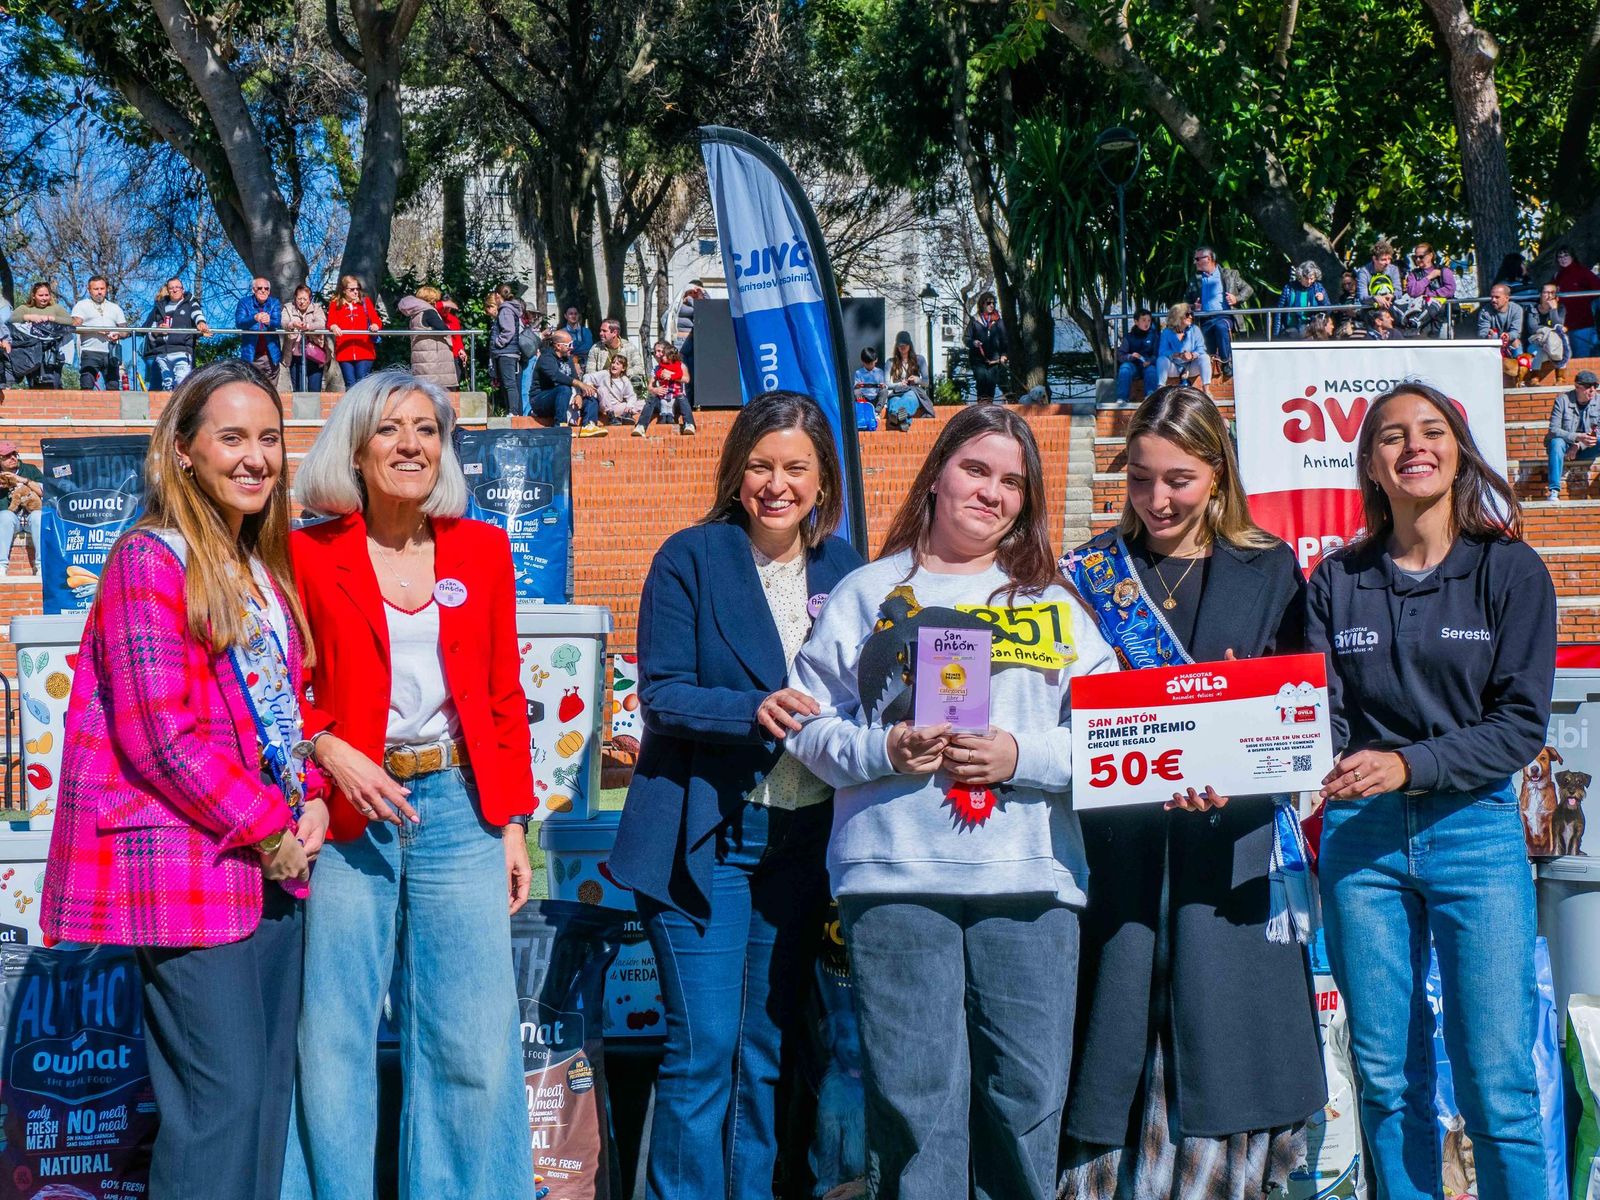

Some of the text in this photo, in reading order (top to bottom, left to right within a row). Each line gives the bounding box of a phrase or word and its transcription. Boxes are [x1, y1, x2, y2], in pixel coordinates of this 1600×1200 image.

[1303, 452, 1355, 468] Animal
[487, 487, 541, 500] ownat
[69, 496, 123, 511] ownat
[68, 527, 80, 537] only
[88, 529, 104, 543] NO
[67, 535, 84, 544] FRESH
[66, 543, 83, 551] MEAT
[72, 554, 107, 564] NATURA
[944, 630, 961, 641] San
[1334, 631, 1378, 648] ávila
[1440, 628, 1491, 640] Seresto
[1166, 676, 1228, 694] ávila
[1088, 712, 1157, 728] SAN ANTÓN
[1088, 721, 1196, 740] PRIMER PREMIO
[1546, 719, 1588, 748] sbi
[1087, 736, 1156, 749] CHEQUE REGALO
[1088, 749, 1184, 788] 50€
[620, 968, 658, 981] VERDA
[520, 1020, 564, 1045] nat
[33, 1045, 131, 1075] ownat
[529, 1051, 548, 1059] FOOD
[87, 1075, 112, 1085] FOOD
[537, 1084, 564, 1098] meat
[537, 1096, 565, 1109] meal
[27, 1104, 50, 1123] only
[99, 1104, 128, 1120] meat
[26, 1120, 59, 1135] FRESH
[67, 1109, 96, 1134] NO
[98, 1118, 128, 1132] meal
[26, 1134, 58, 1150] MEAT
[40, 1153, 113, 1177] NATURAL
[539, 1157, 582, 1170] 60% FRESH
[547, 1171, 569, 1180] ROOSTER
[101, 1179, 145, 1193] 60% FRESH
